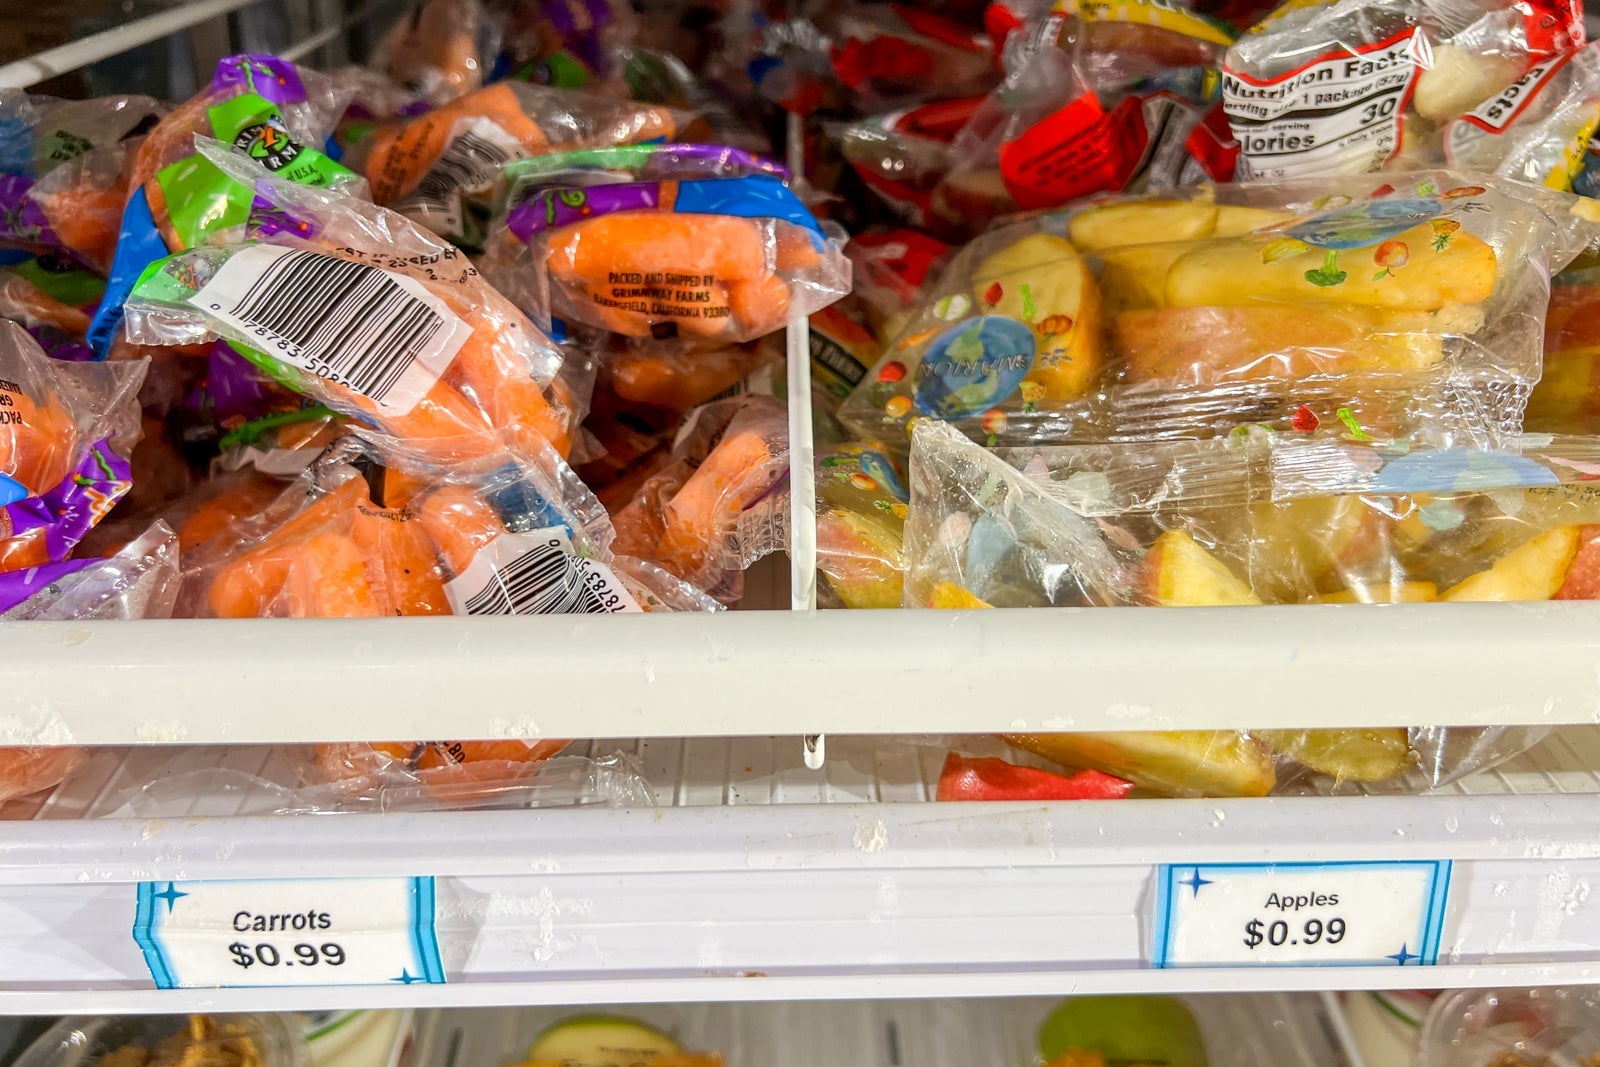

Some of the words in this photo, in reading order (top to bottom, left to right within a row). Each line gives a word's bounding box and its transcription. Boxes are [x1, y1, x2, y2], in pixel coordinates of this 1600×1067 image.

[1222, 66, 1333, 100] Nutrition
[1344, 48, 1411, 78] Facts
[1224, 101, 1268, 117] erving
[1303, 93, 1309, 104] 1
[1487, 67, 1545, 120] Facts
[1359, 97, 1397, 125] 30
[1243, 132, 1316, 152] lories
[608, 271, 643, 285] PACKED
[665, 272, 701, 287] SHIPPED
[612, 287, 674, 301] GRIMMWAY
[675, 290, 711, 303] FARMS
[244, 321, 304, 359] 78783
[1263, 891, 1340, 912] Apples
[232, 909, 333, 932] Carrots
[1242, 918, 1346, 950] $0.99
[228, 941, 346, 969] $0.99
